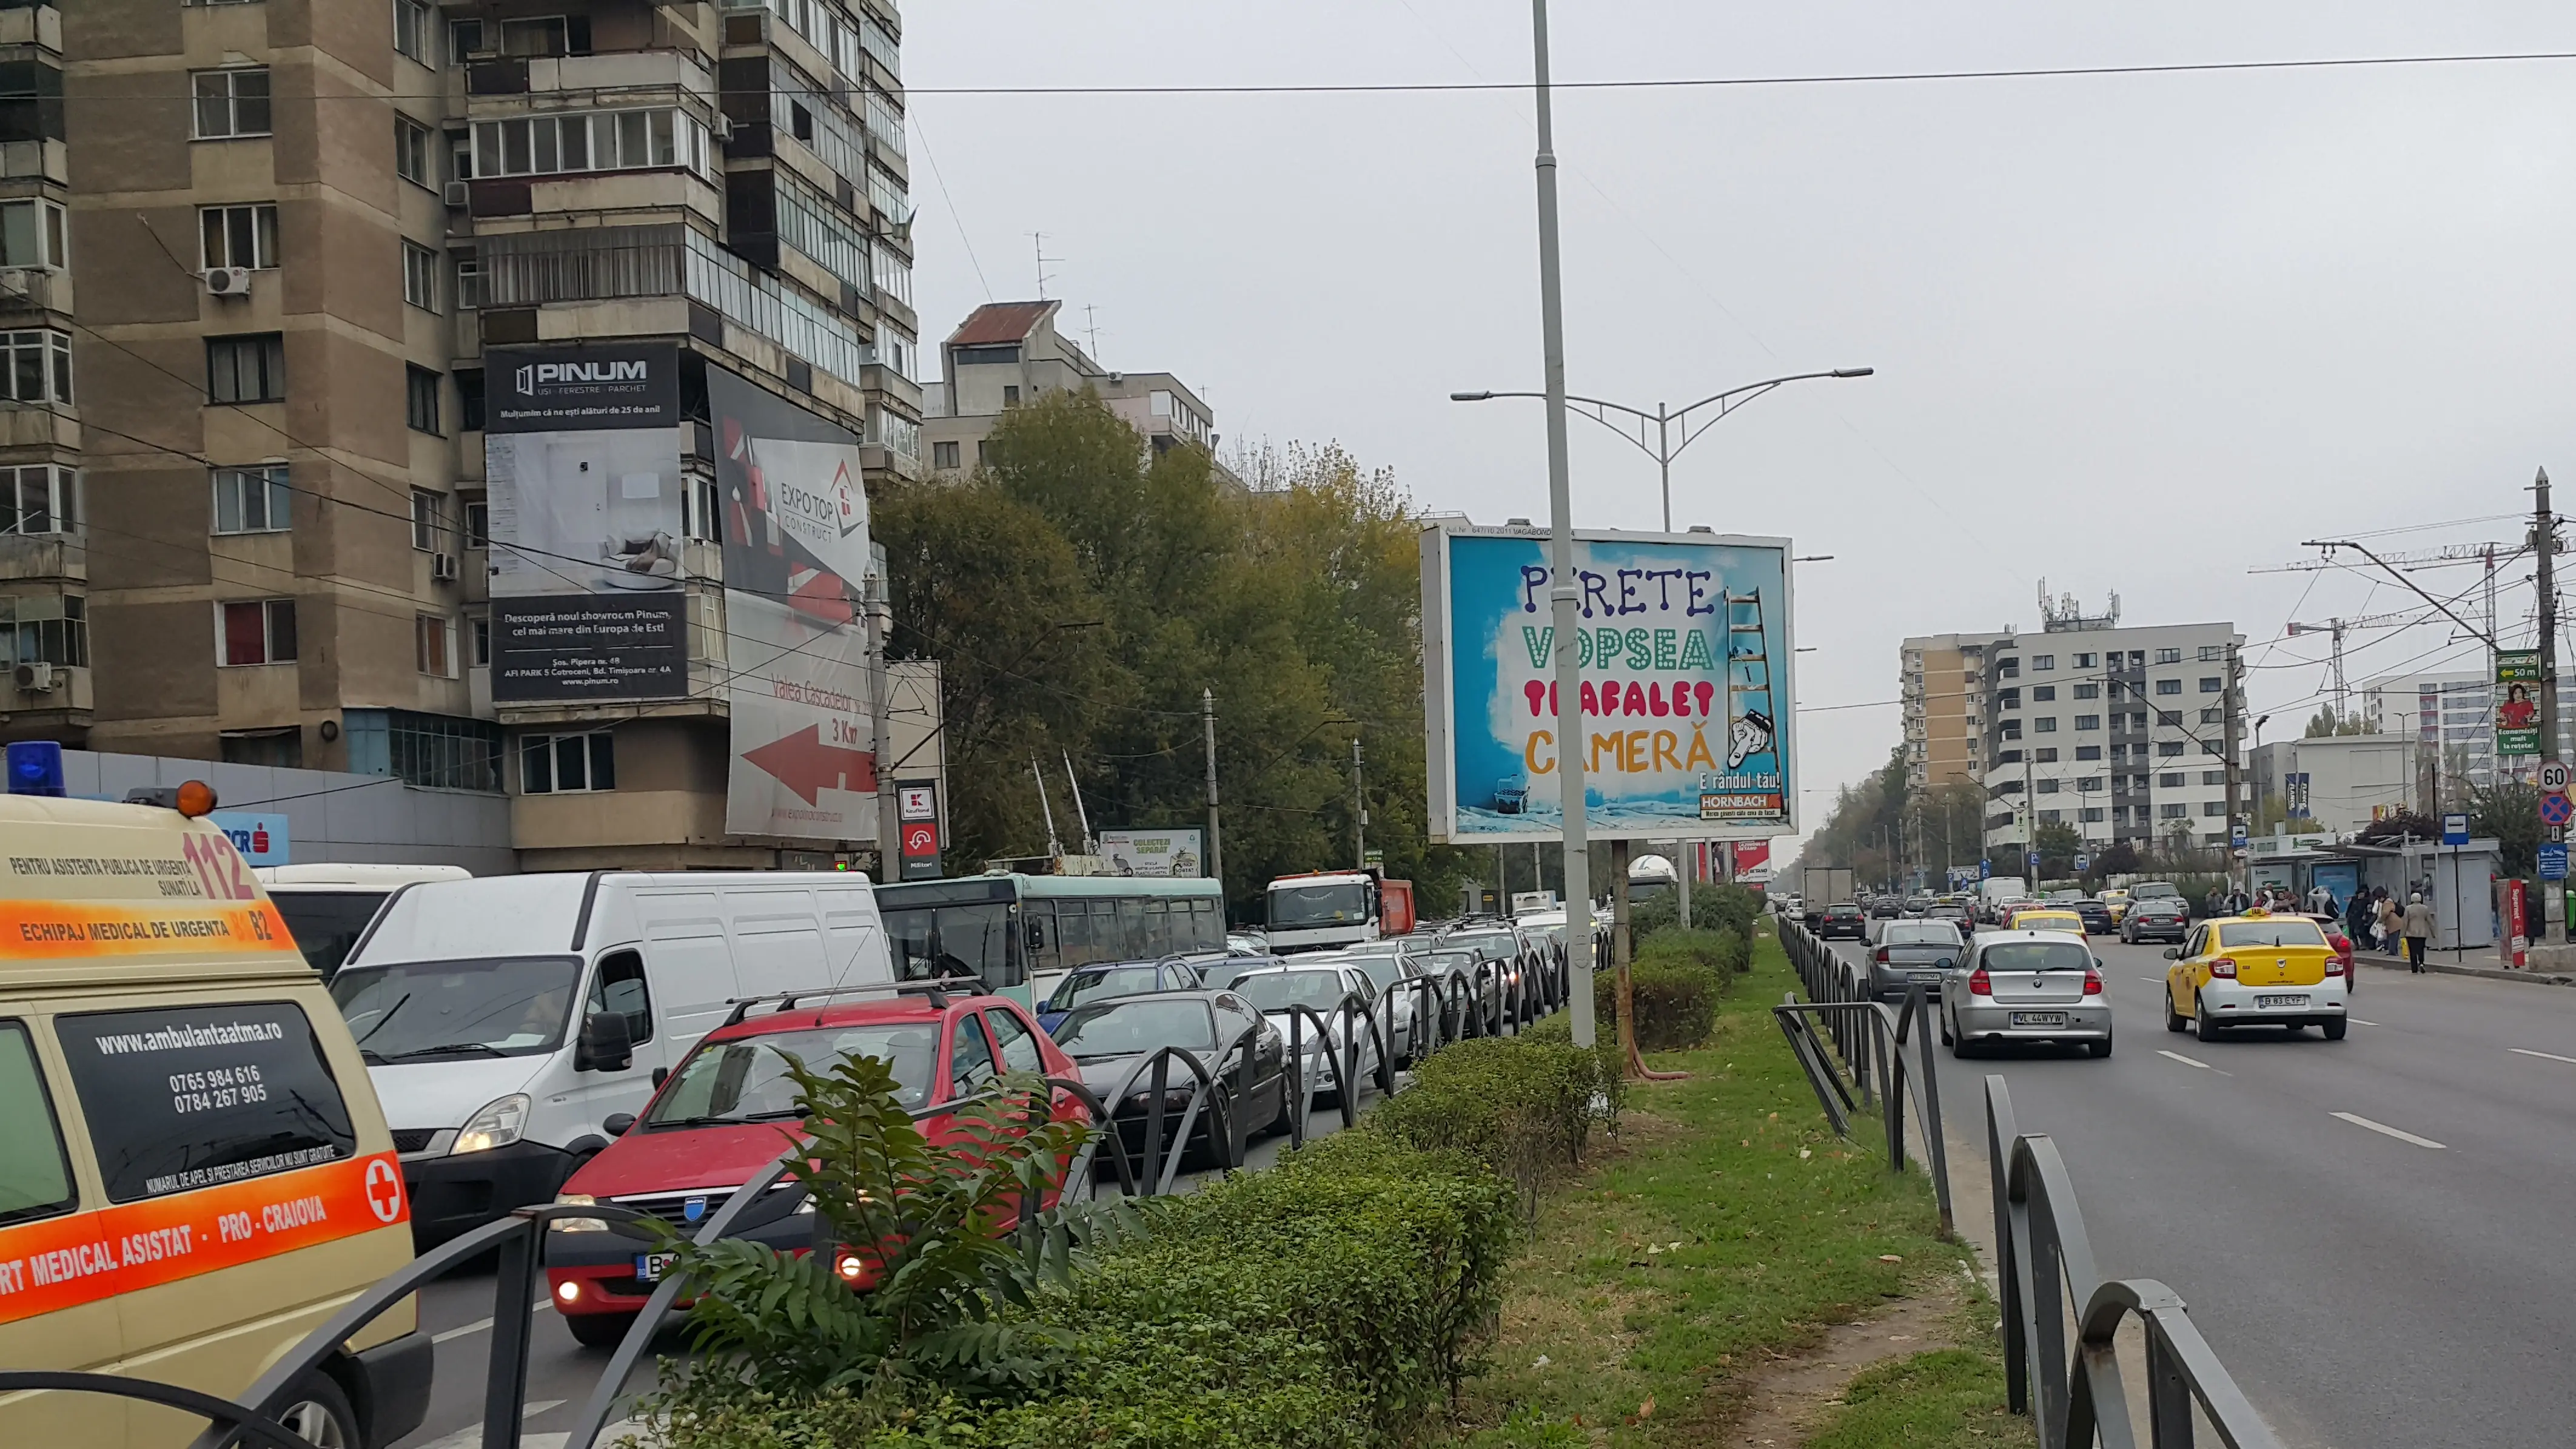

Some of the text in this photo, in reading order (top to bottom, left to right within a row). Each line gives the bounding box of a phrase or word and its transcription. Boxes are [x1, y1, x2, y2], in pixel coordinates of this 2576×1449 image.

[537, 361, 647, 383] PINUM
[608, 385, 646, 393] PARCHET
[609, 406, 619, 414] de
[780, 482, 833, 522] EXPO TOP
[785, 515, 832, 544] CONSTRUCT
[1521, 566, 1714, 618] PRETE
[504, 612, 555, 624] Descoperă
[557, 611, 580, 621] noul
[581, 610, 634, 620] showroom
[512, 627, 526, 636] cel
[528, 625, 546, 635] mai
[576, 624, 592, 634] din
[594, 624, 629, 636] Europa
[631, 624, 644, 633] de
[2514, 668, 2526, 677] 50
[771, 673, 802, 701] Valea
[805, 679, 851, 713] Cascadelor
[832, 718, 857, 745] 3 Km
[1525, 719, 1717, 775] CMERĂ
[1700, 770, 1780, 789] E rândul tău!
[2543, 768, 2564, 785] 60
[1702, 796, 1766, 807] HORNBACH
[9, 857, 52, 875] PENTRU
[51, 858, 104, 875] ASISTENTA
[100, 858, 142, 875] PUBLICA
[138, 859, 155, 875] DE
[183, 832, 255, 899] 112
[187, 880, 202, 896] LA
[20, 922, 86, 941] ECHIPAJ
[87, 921, 151, 941] MEDICAL
[151, 921, 170, 939] DE
[172, 920, 230, 937] URGENTA
[248, 910, 273, 941] B2
[95, 1021, 283, 1054] www.ambulantaatma.ro
[170, 1064, 260, 1092] 0765 984 616
[174, 1083, 267, 1114] 0784 267 905
[146, 1174, 179, 1194] NUMARUL
[179, 1172, 190, 1187] DE
[190, 1169, 207, 1186] APEL
[213, 1162, 249, 1181] PRESTAREA
[293, 1149, 309, 1165] SUNT
[308, 1144, 335, 1162] GRATUITE
[30, 1240, 118, 1286] MEDICAL
[121, 1225, 192, 1267] ASISTAT
[218, 1211, 252, 1243] PRO
[263, 1195, 327, 1233] CRAIOVA
[649, 1256, 663, 1274] B
